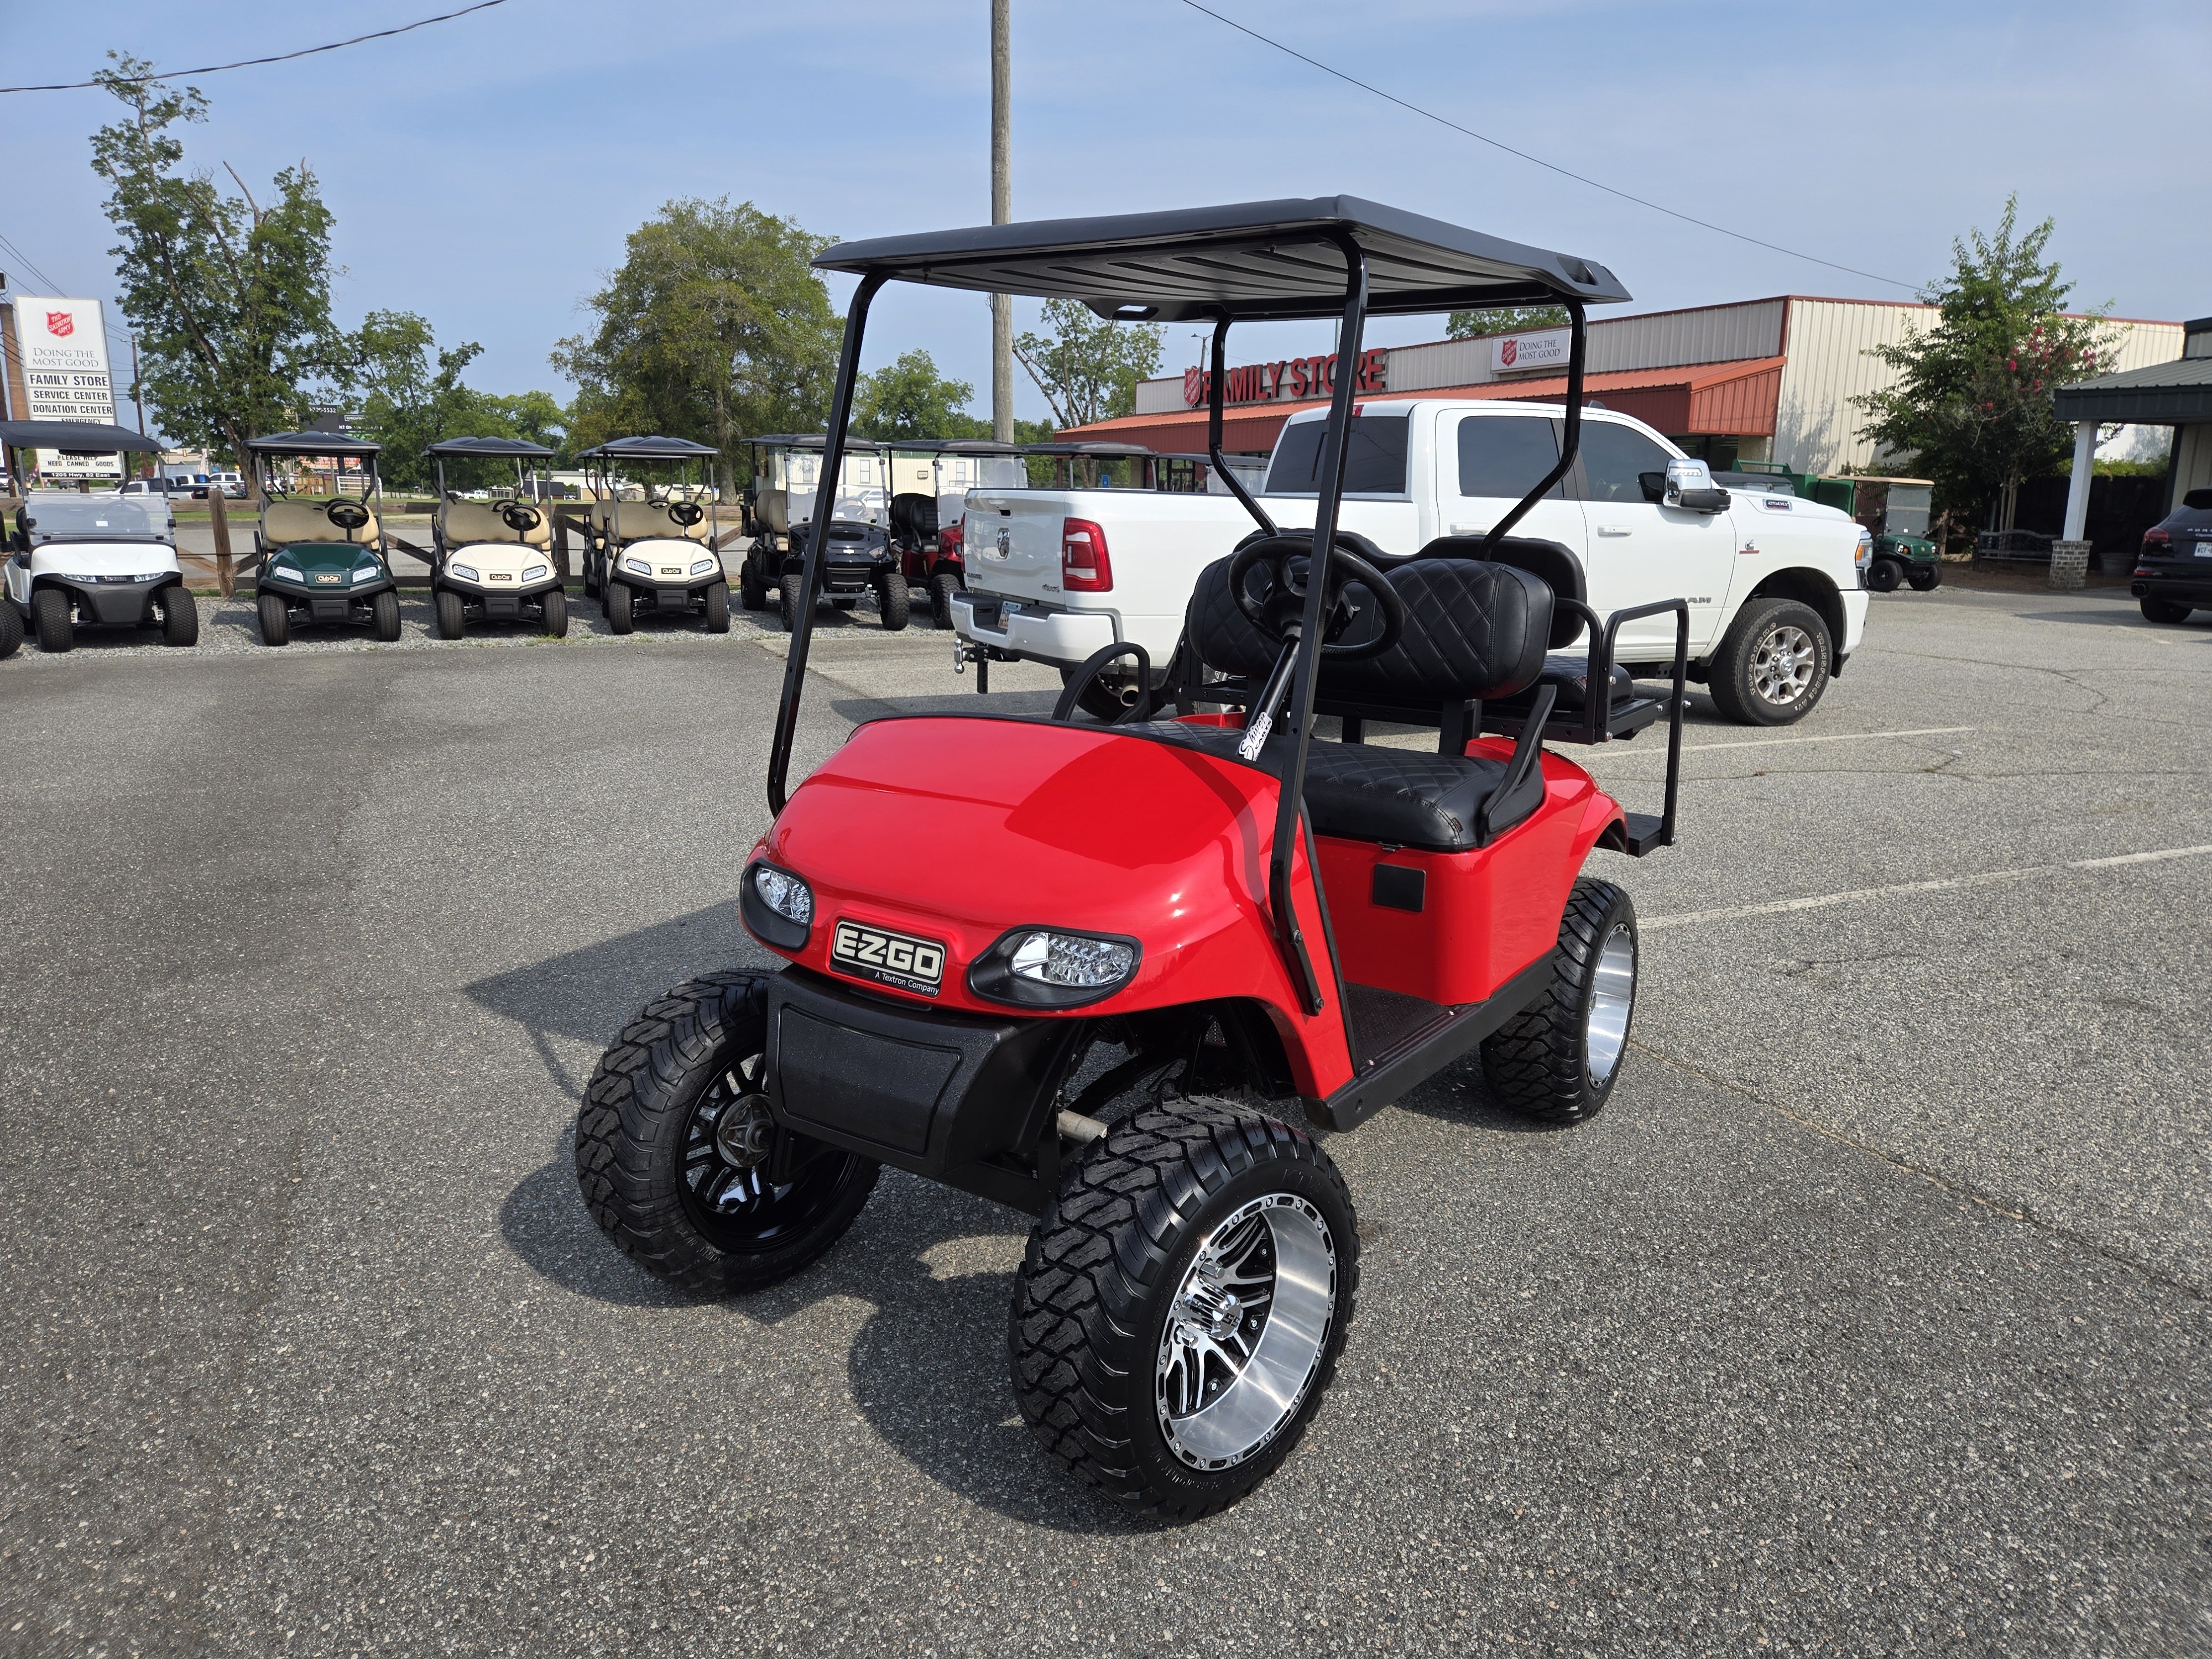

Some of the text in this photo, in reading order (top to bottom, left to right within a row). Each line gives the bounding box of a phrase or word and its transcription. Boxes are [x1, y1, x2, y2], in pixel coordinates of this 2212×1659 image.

[51, 314, 62, 322] THE
[58, 323, 71, 335] ARMY
[1520, 340, 1557, 351] DOING THE
[34, 347, 72, 357] DOING
[1519, 348, 1560, 360] MOST GOOD
[65, 359, 98, 367] GOOD
[30, 374, 108, 386] FAMILY STORE
[34, 390, 108, 400] SERVICE CENTER
[33, 404, 112, 414] DONATION CENTER
[882, 973, 906, 985] Textron
[908, 980, 940, 995] Company
